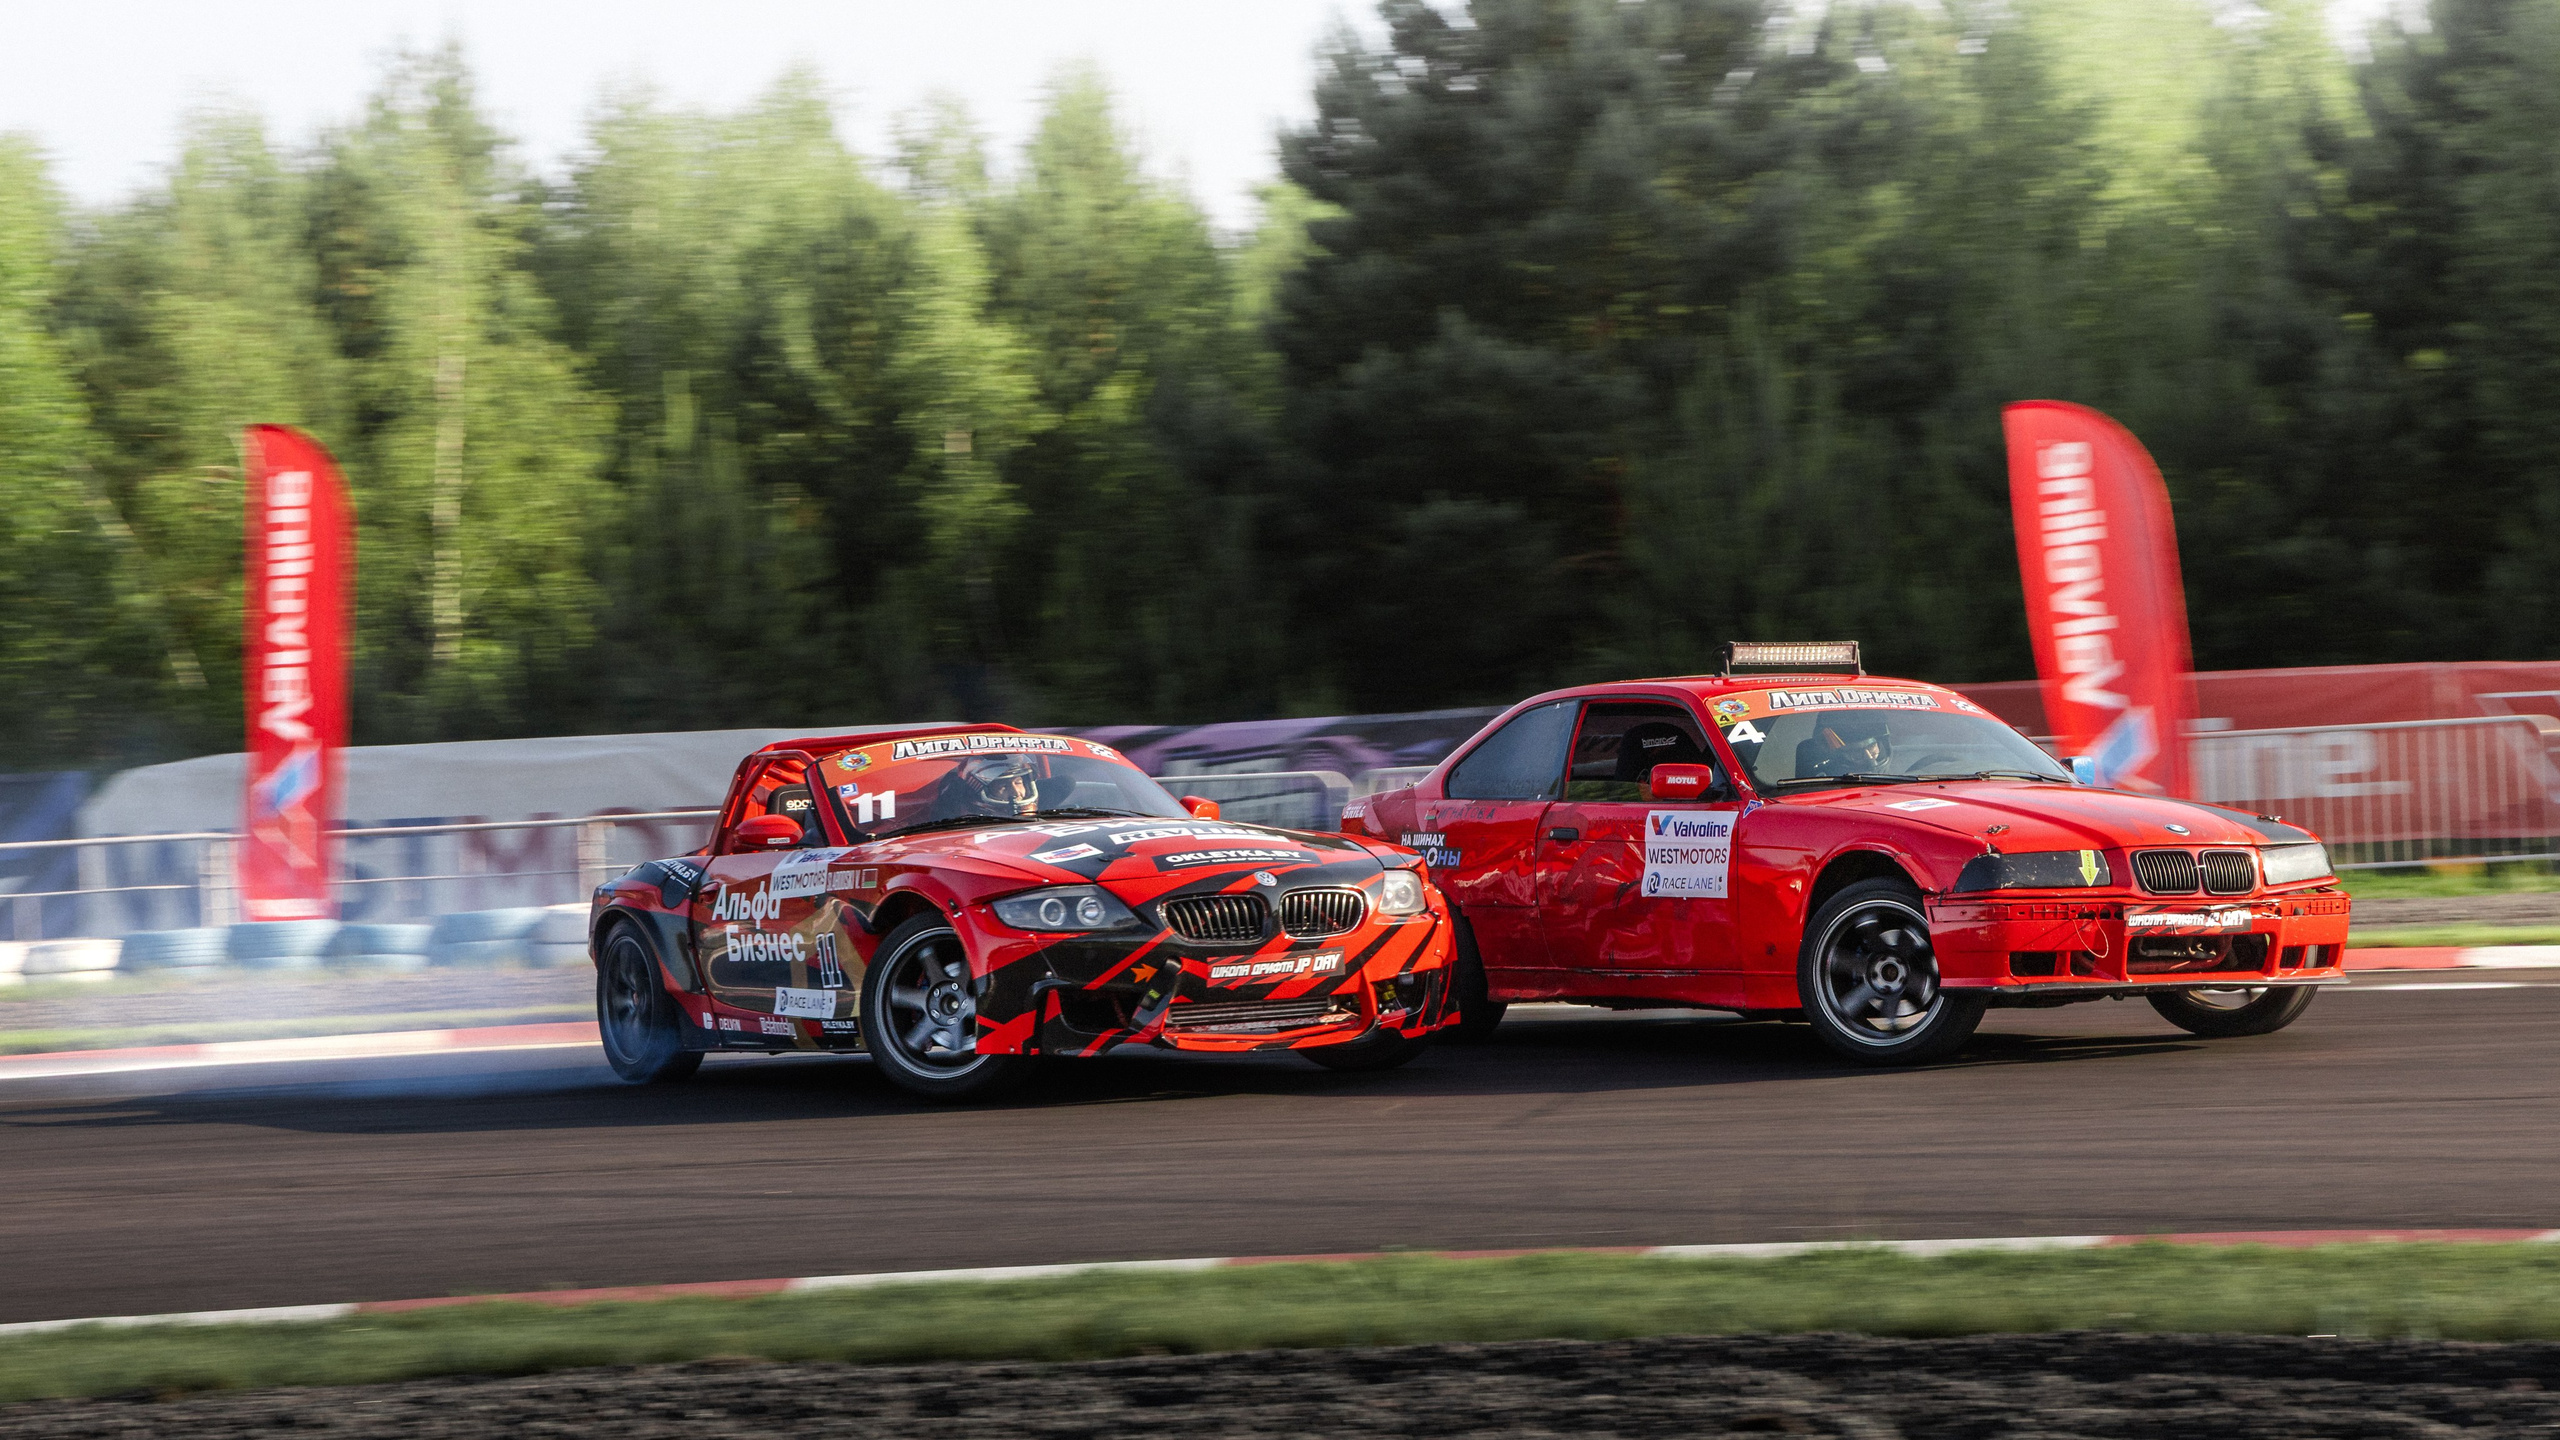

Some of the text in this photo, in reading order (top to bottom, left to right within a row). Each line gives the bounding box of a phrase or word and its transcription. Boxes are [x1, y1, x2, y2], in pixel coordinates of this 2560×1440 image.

[1728, 720, 1766, 744] 4
[1667, 776, 1697, 785] MOTUL
[850, 790, 896, 824] 11
[1673, 821, 1728, 837] Valvoline
[1401, 834, 1445, 847] НА ШИНАХ
[1165, 850, 1301, 863] OKLEYKA.BY
[1648, 848, 1727, 865] WESTMOTORS
[772, 869, 827, 892] WESTMOTORS
[1662, 877, 1686, 890] RACE
[1687, 877, 1713, 890] LANE
[711, 880, 781, 930] Альфа
[726, 924, 807, 962] Бизнес
[815, 931, 844, 989] 11
[1211, 953, 1341, 979] ШКОЛА ДРИФТА JP DAY
[789, 996, 807, 1009] RACE
